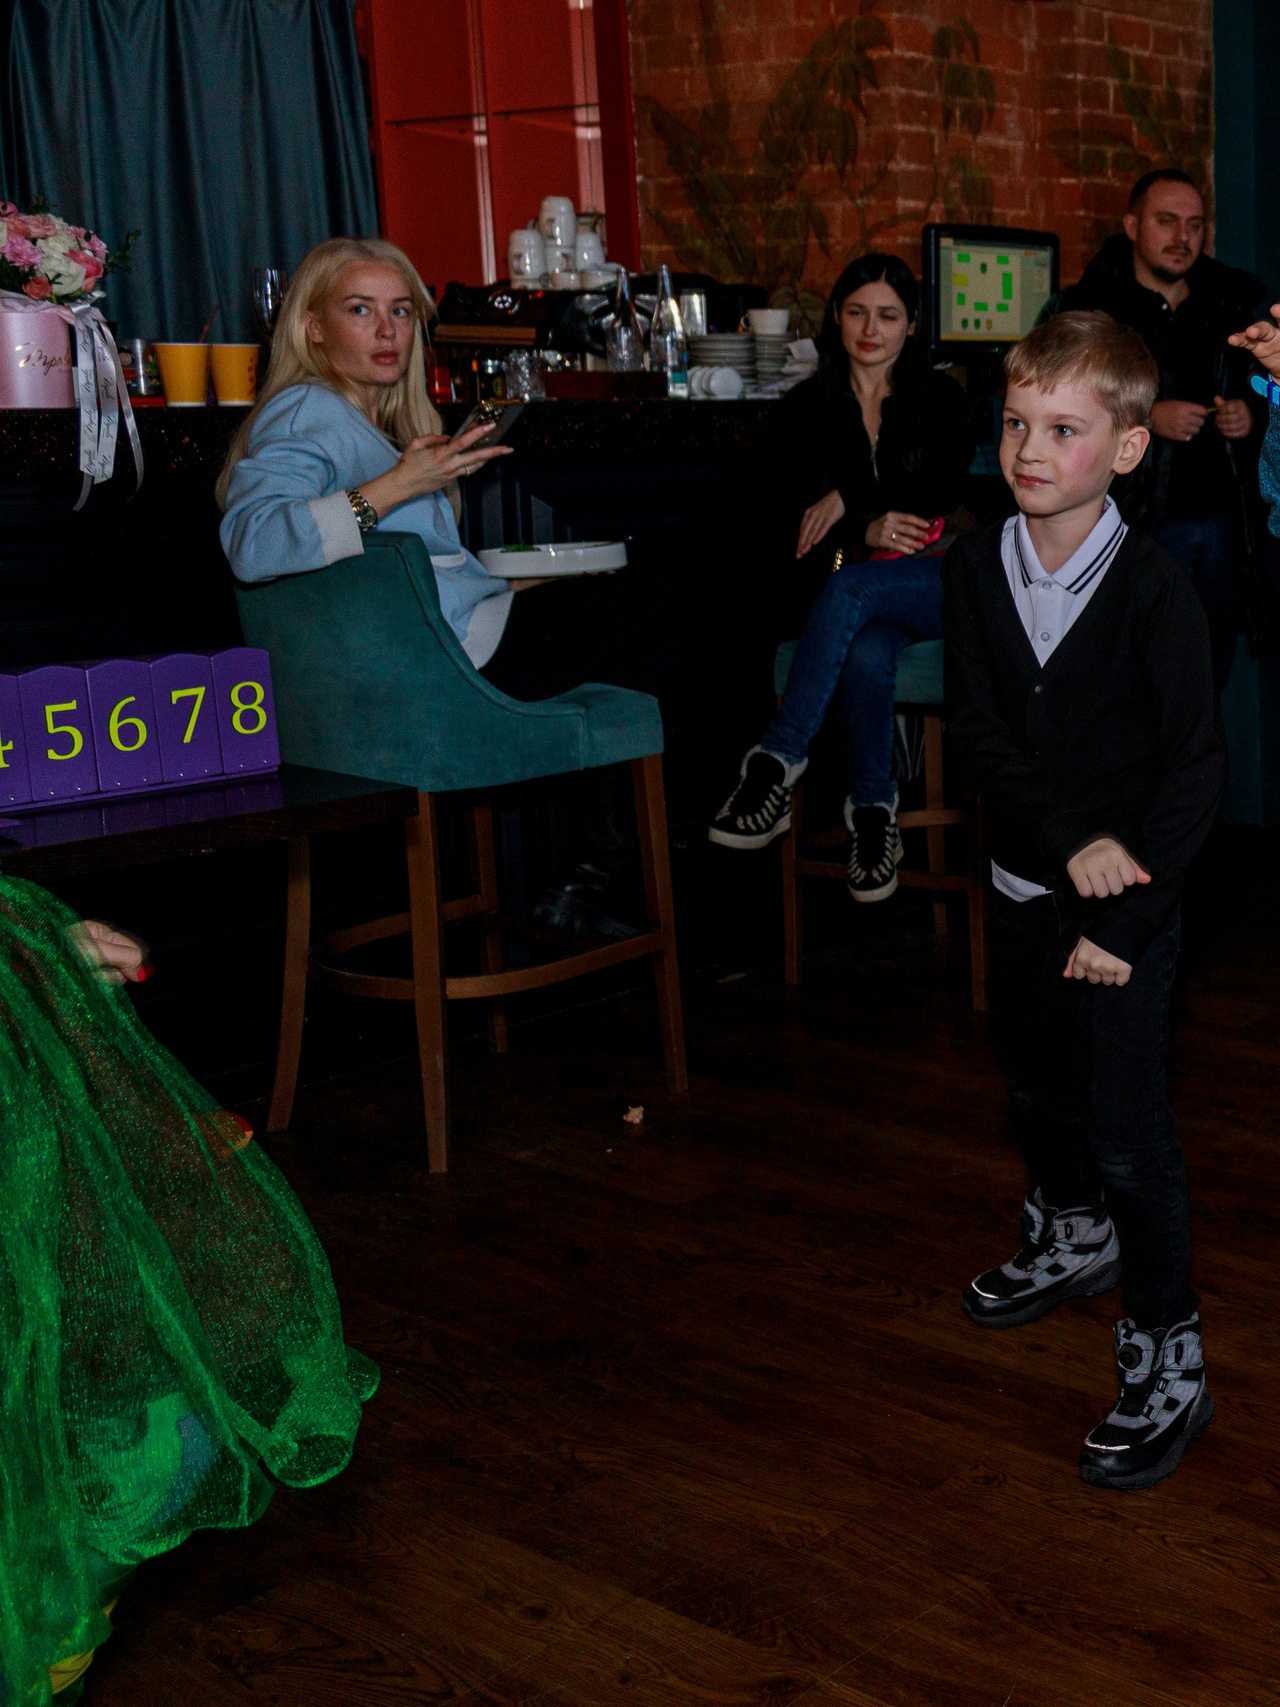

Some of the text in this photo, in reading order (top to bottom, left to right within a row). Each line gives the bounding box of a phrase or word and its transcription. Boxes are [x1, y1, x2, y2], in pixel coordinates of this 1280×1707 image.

[44, 699, 84, 760] 5
[108, 695, 148, 752] 6
[170, 686, 206, 744] 7
[229, 681, 268, 735] 8
